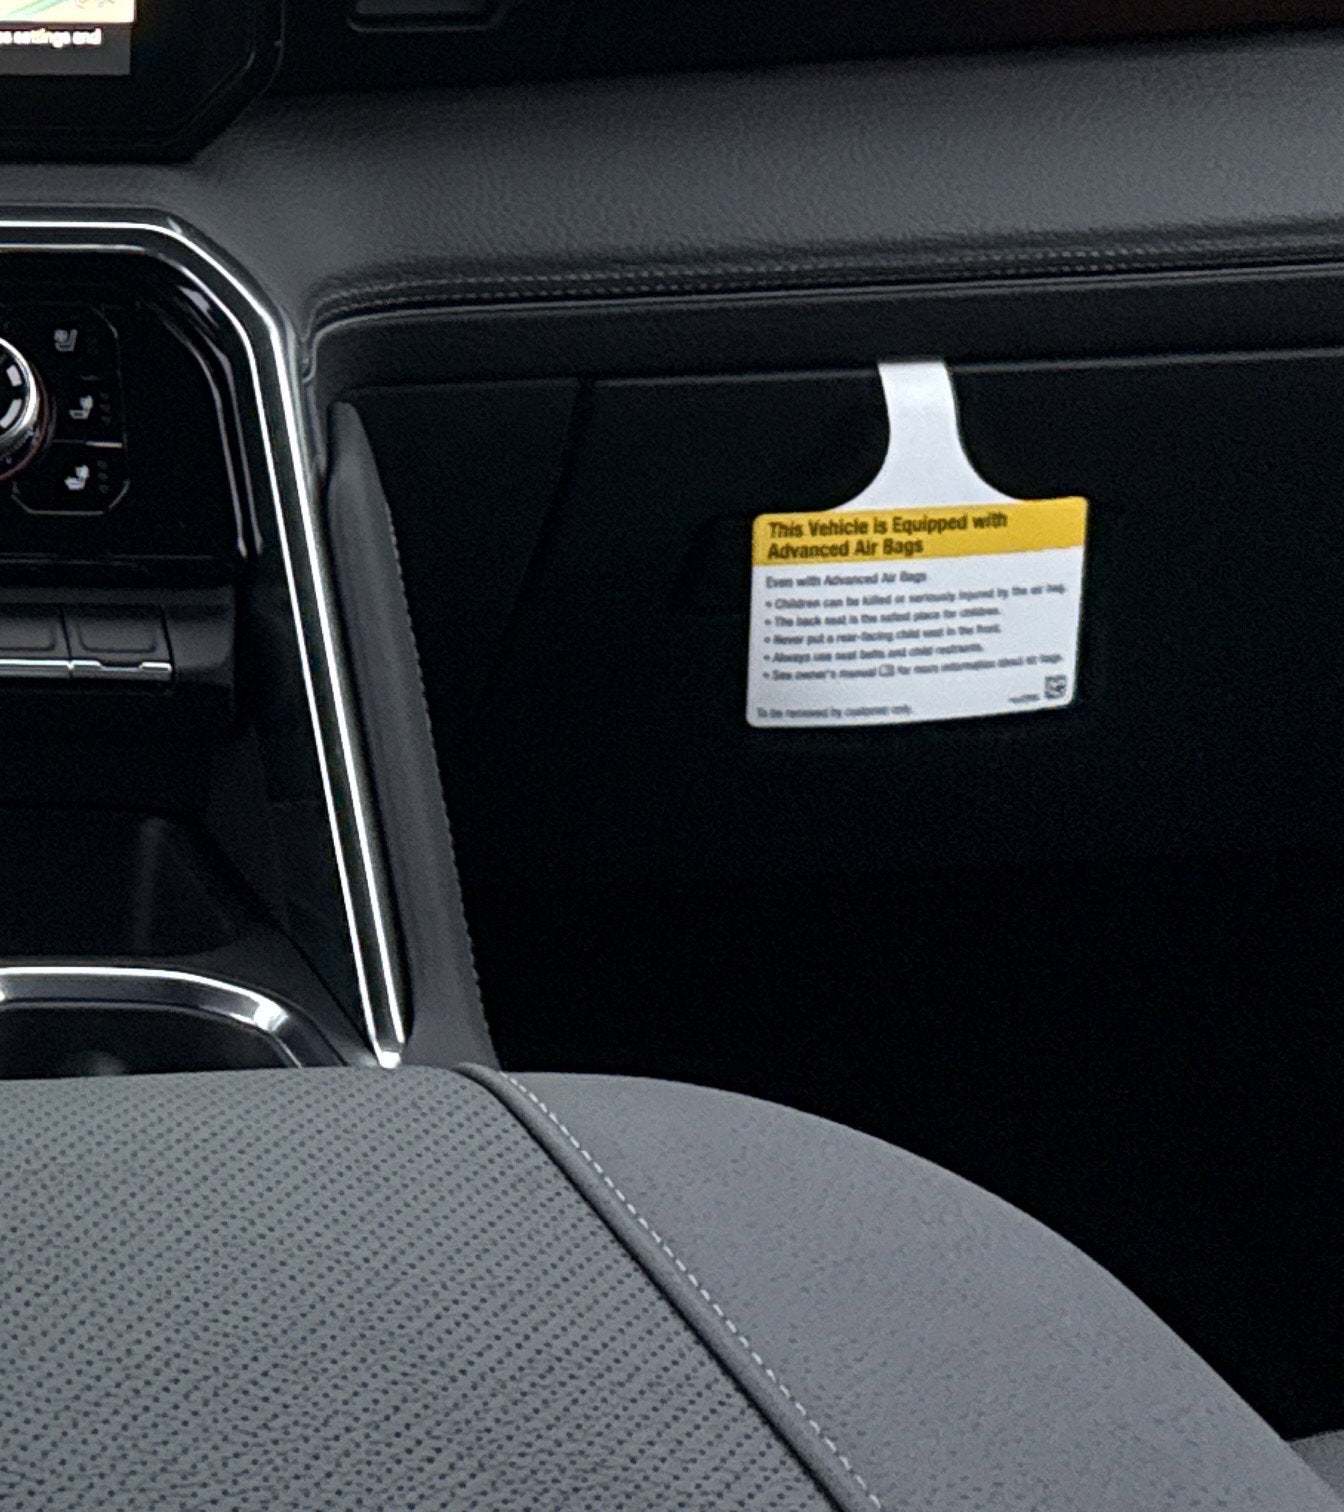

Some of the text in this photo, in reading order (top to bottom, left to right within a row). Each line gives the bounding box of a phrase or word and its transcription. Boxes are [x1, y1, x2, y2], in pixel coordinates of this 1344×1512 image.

[767, 511, 1009, 539] This Vehicle is Equipped with
[767, 537, 924, 560] Advanced Air Bags
[767, 571, 927, 588] Even with Advanced Air Bags
